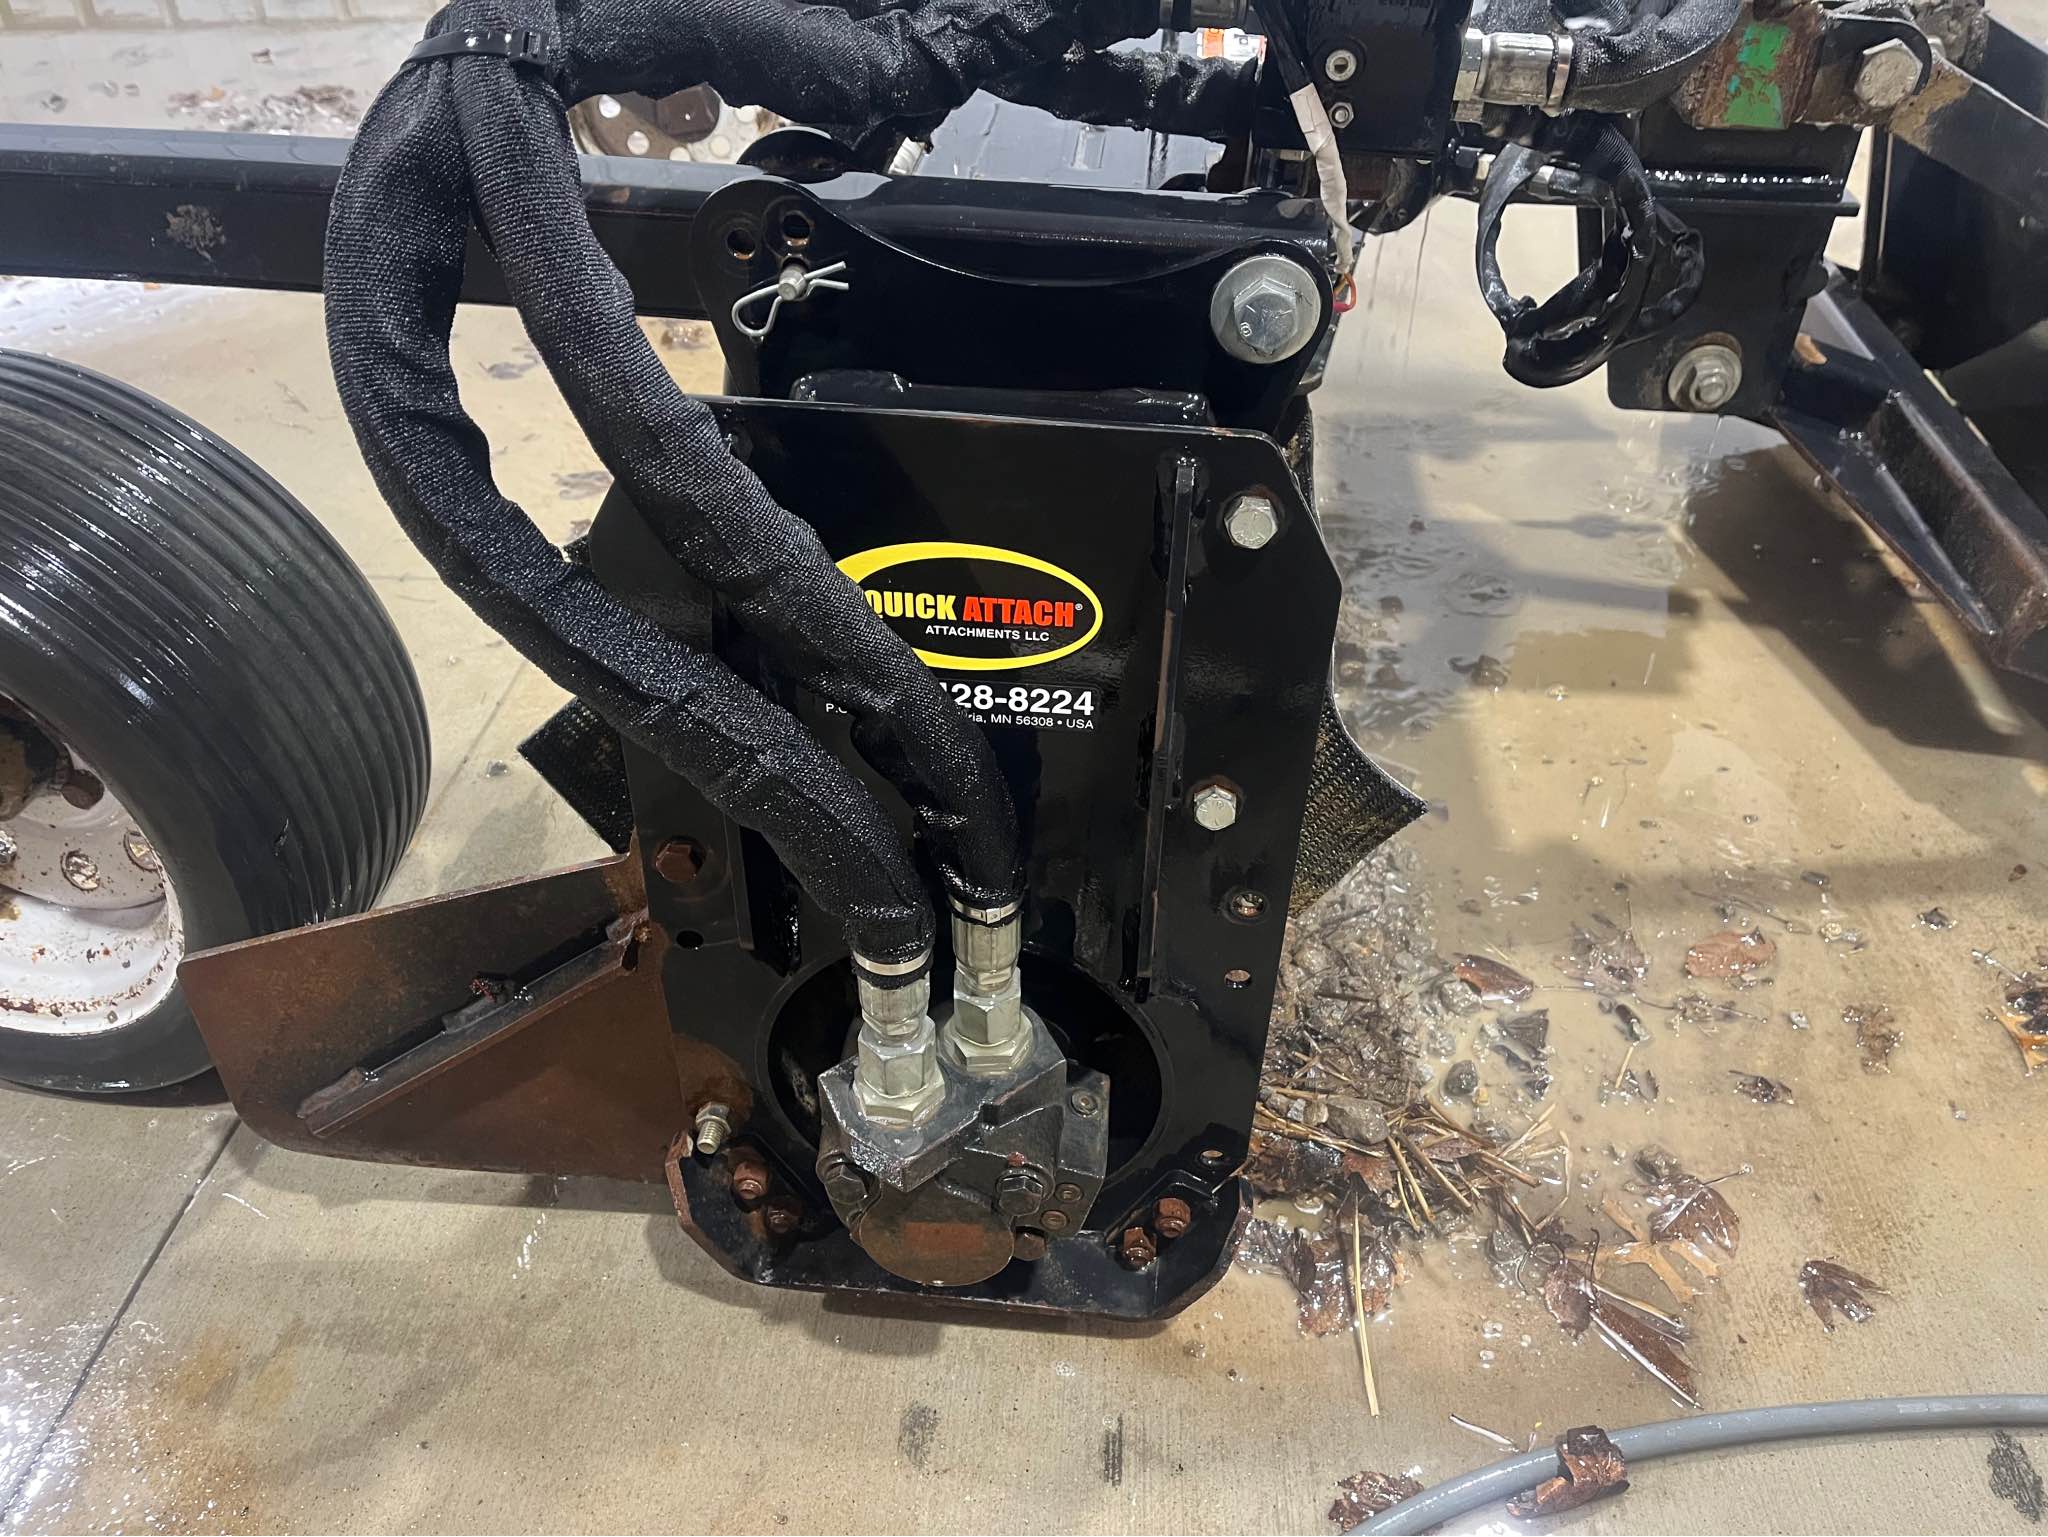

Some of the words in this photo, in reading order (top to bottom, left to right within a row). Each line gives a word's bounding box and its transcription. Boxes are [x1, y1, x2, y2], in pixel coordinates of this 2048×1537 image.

[864, 589, 957, 621] QUICK
[925, 624, 1020, 640] ATTACHMENTS
[1025, 630, 1050, 642] LLC
[940, 681, 1095, 716] 28-8224
[991, 713, 1012, 724] MN
[1015, 715, 1054, 727] 56308
[1066, 718, 1094, 729] USA
